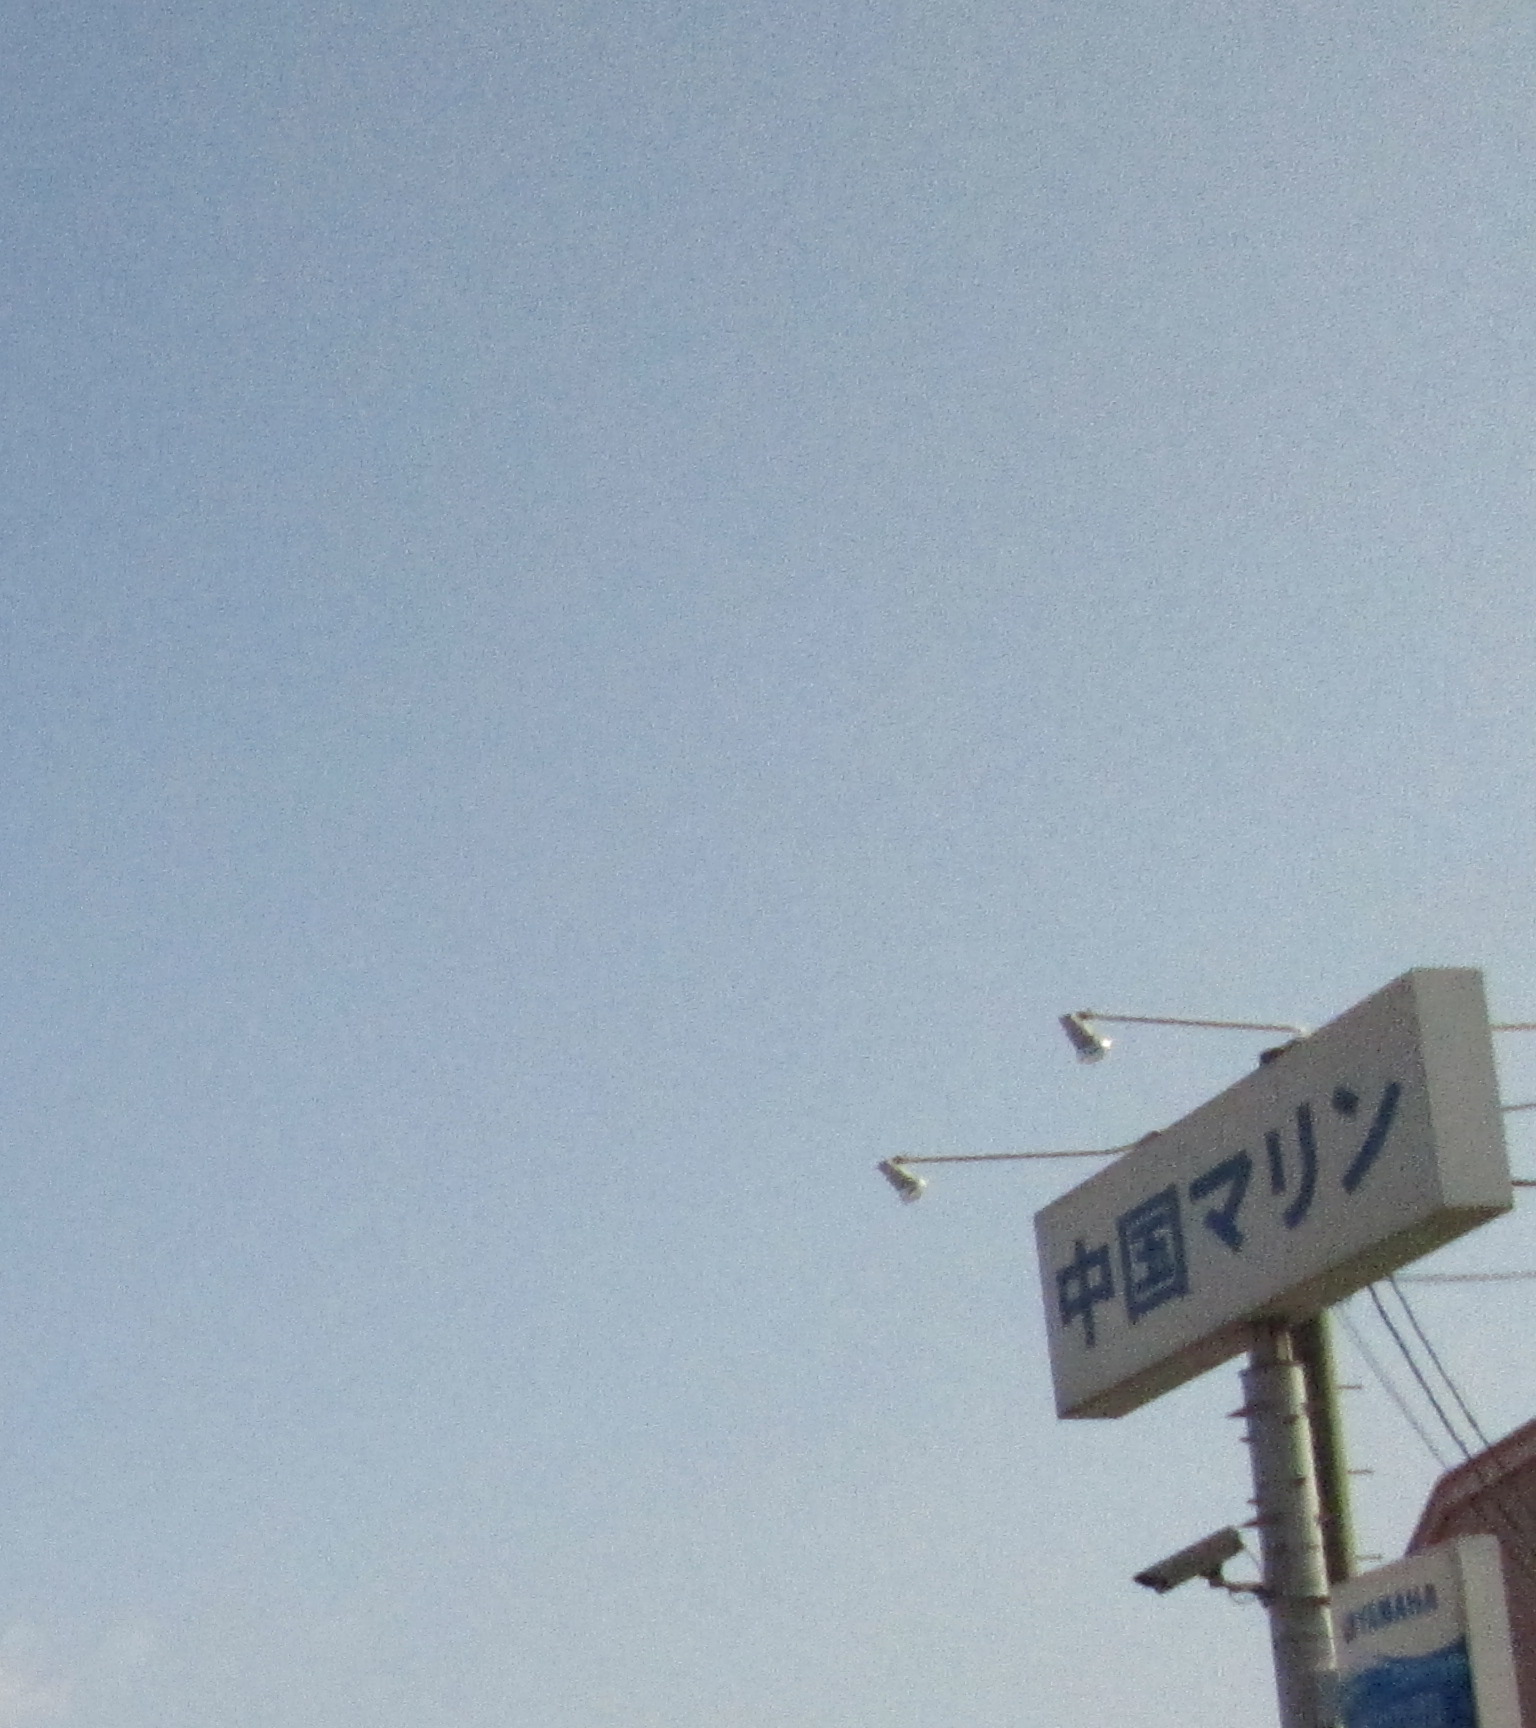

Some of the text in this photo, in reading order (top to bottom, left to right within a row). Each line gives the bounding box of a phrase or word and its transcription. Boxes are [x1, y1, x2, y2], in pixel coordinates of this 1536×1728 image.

[1055, 1081, 1402, 1349] 中国マリン
